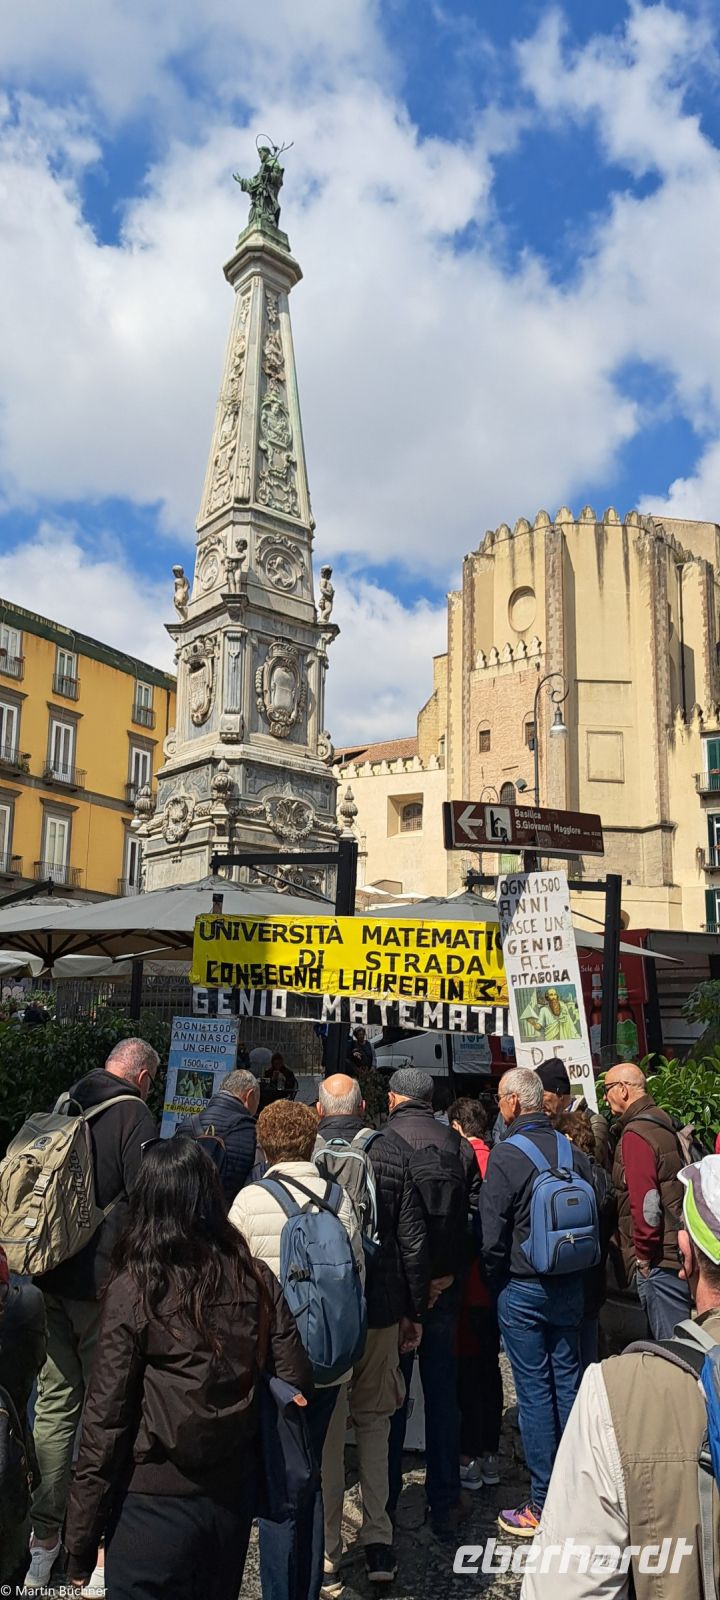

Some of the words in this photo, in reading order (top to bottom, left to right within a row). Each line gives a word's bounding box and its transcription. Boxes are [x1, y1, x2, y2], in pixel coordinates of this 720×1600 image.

[514, 808, 541, 820] Basilica
[553, 823, 581, 836] Maggiore
[500, 879, 531, 896] OGNI
[500, 897, 548, 917] ANNI
[199, 918, 343, 944] UNIVERSITÀ
[502, 918, 537, 937] NASCE
[544, 916, 564, 932] UN
[507, 936, 562, 955] GENIO
[298, 949, 324, 969] DI
[366, 951, 485, 976] STRADA
[206, 961, 322, 989] CONSEGNA
[339, 970, 428, 998] LAUREA
[440, 985, 464, 1001] IN
[511, 969, 571, 986] PITAGORA
[192, 986, 287, 1017] GENIO
[320, 993, 513, 1036] MATEMATI
[175, 1021, 201, 1032] OGNI
[183, 1043, 196, 1052] UN
[198, 1045, 227, 1054] GENIO
